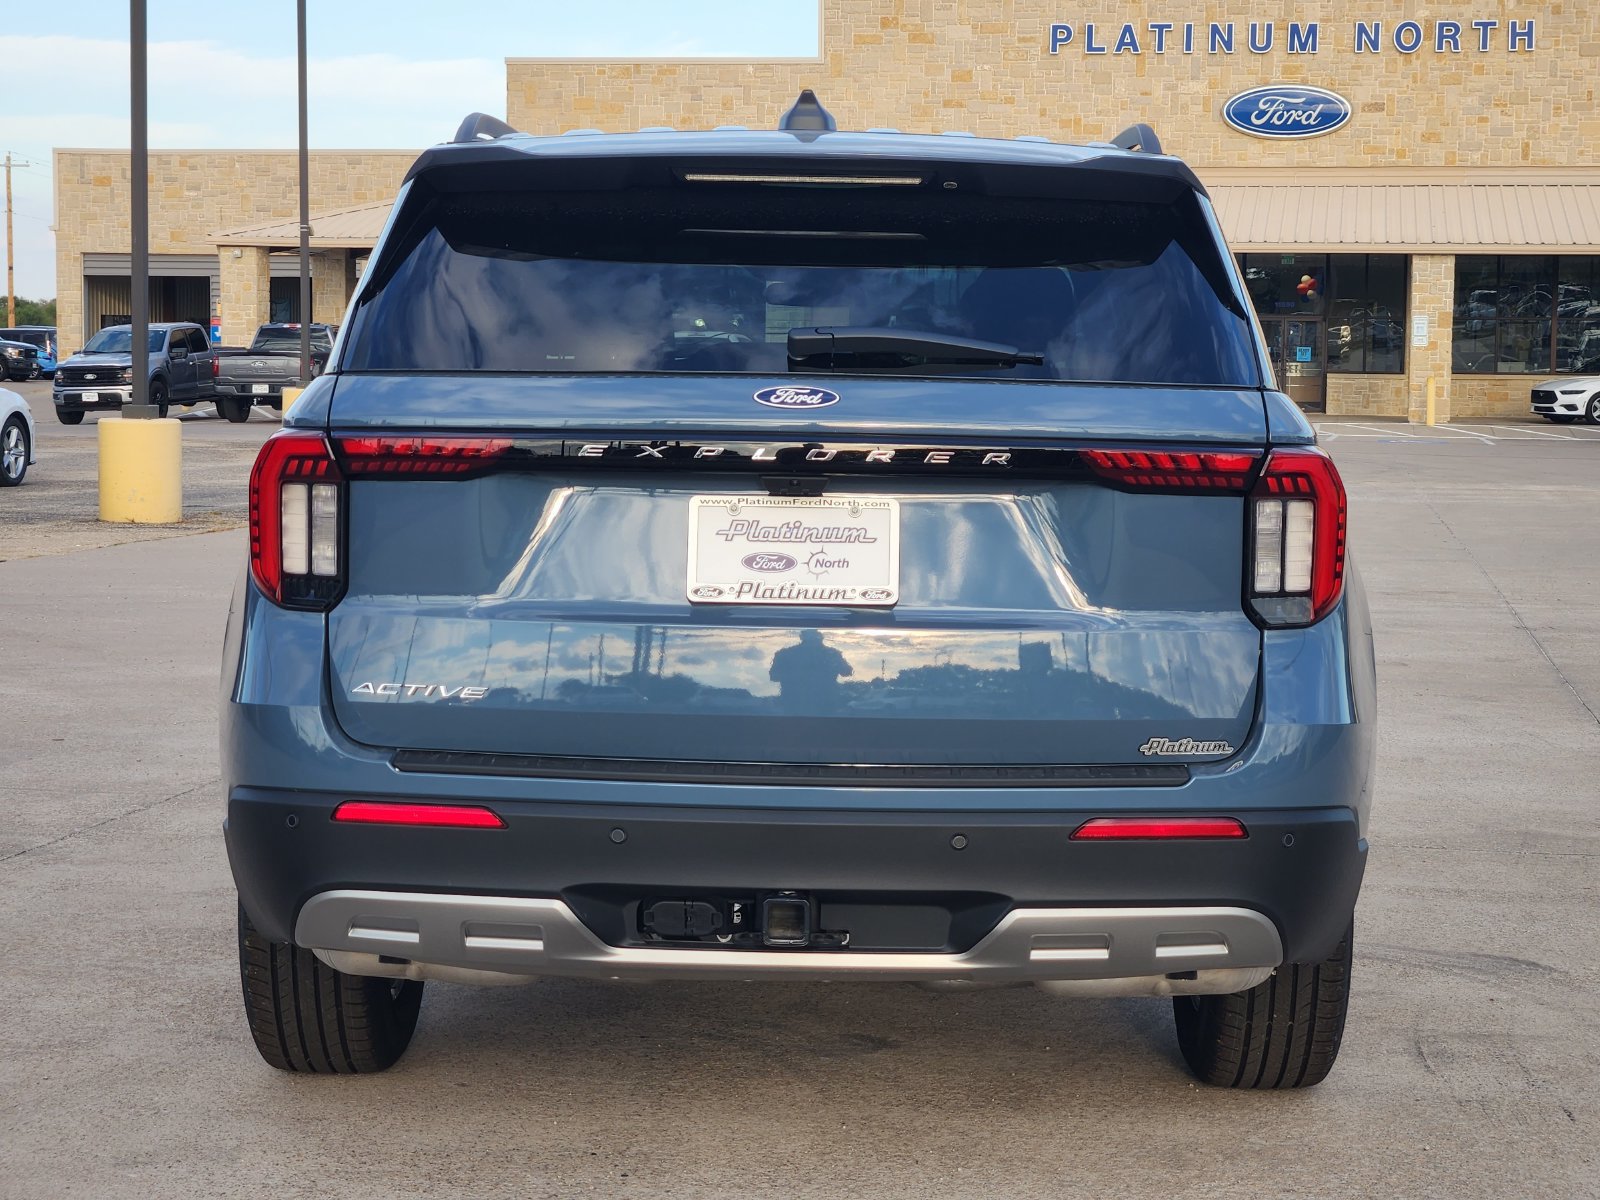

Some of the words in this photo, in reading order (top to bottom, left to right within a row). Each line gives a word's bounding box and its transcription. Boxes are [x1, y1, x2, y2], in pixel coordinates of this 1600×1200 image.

[1049, 22, 1319, 55] PLATINUM
[1354, 19, 1536, 53] NORTH
[1250, 95, 1323, 127] Ford
[769, 387, 822, 405] Ford
[578, 444, 1013, 465] EXPLORER
[699, 497, 890, 508] www.PlatinumFordNorth.com
[715, 519, 877, 544] Platinum
[752, 554, 786, 571] Ford
[815, 557, 850, 569] North
[735, 582, 856, 600] Platinum
[351, 682, 489, 698] ACTIVE
[1140, 738, 1234, 755] Platinum
